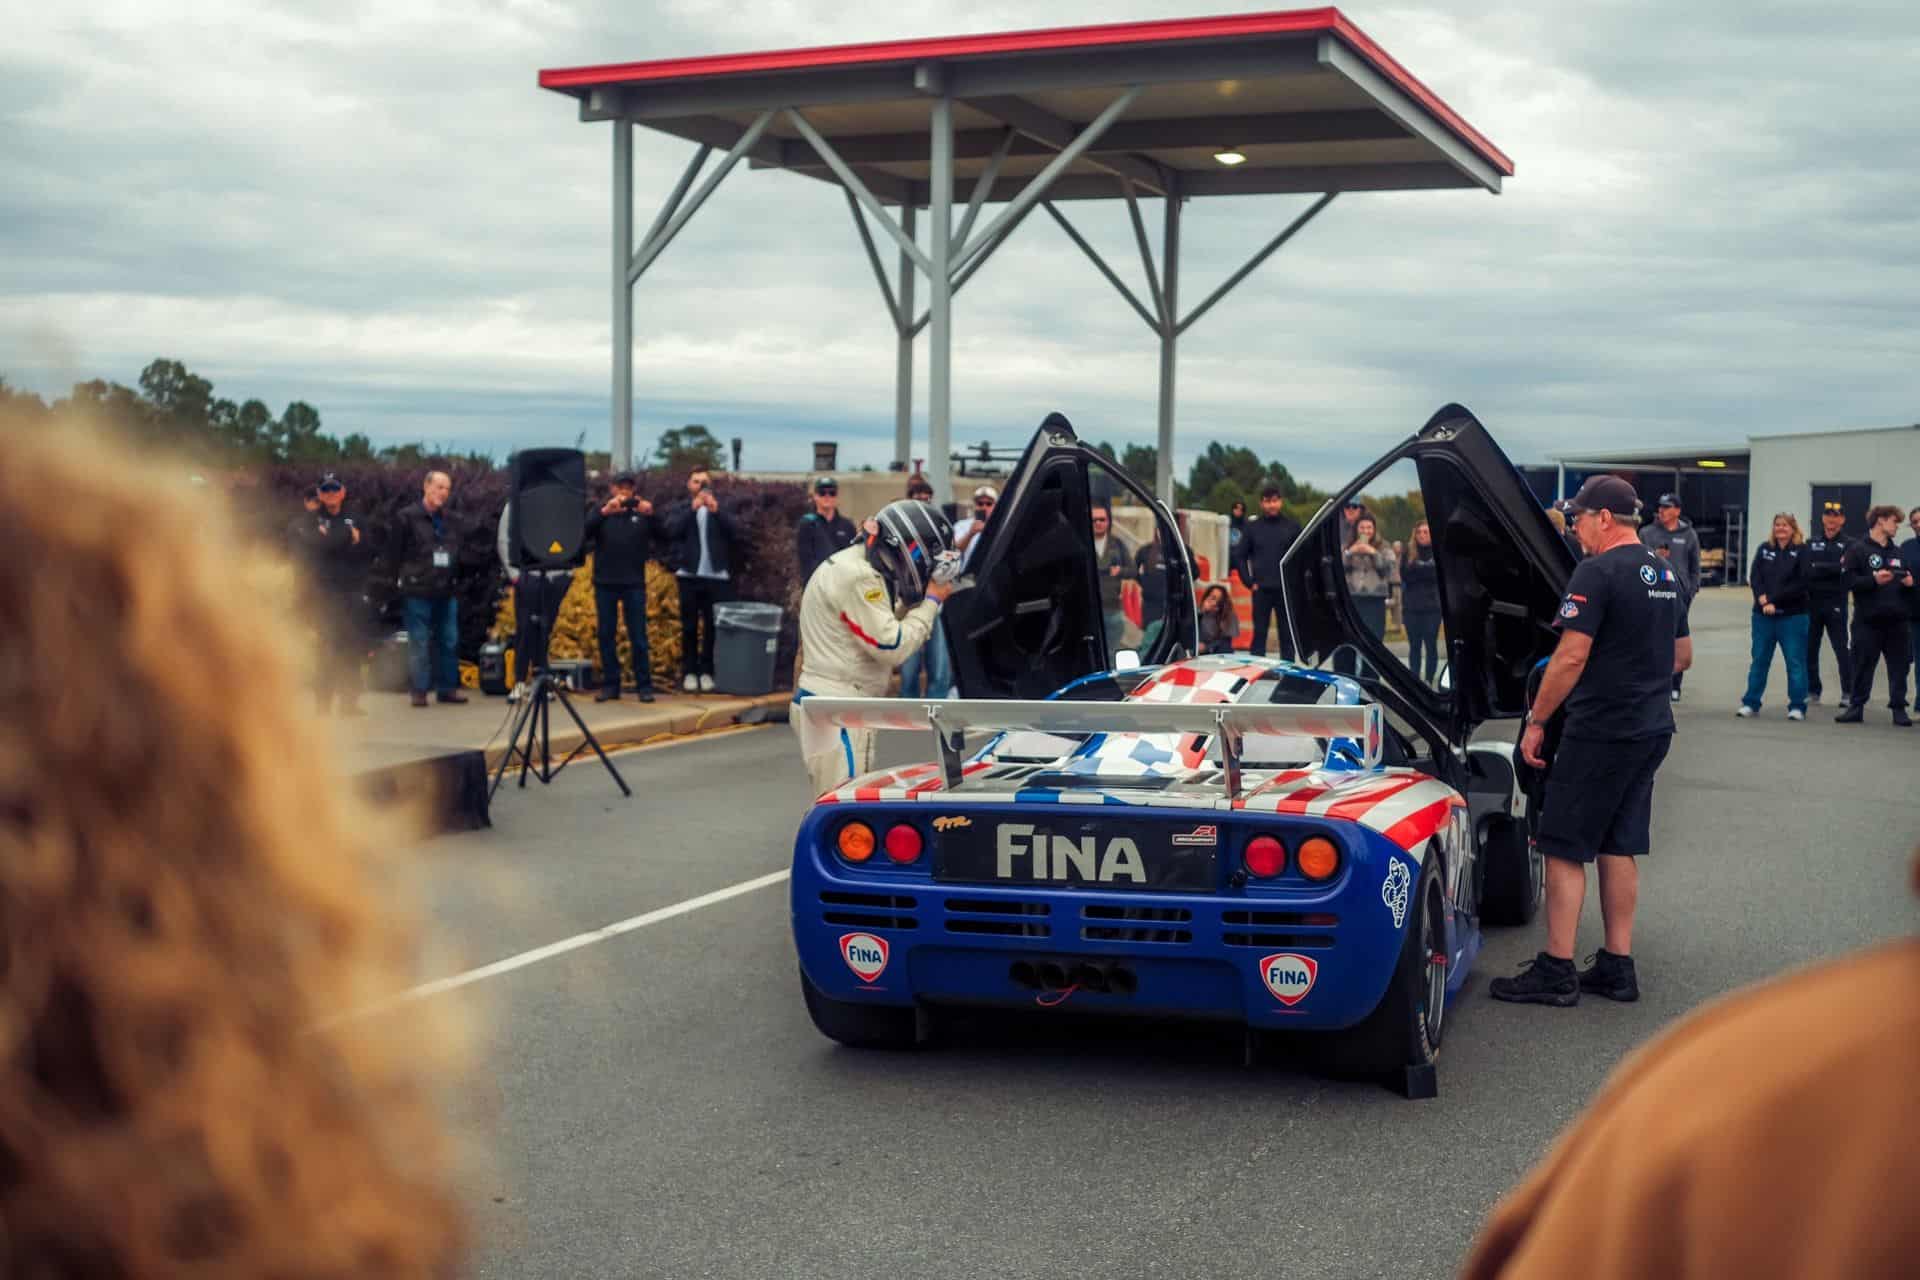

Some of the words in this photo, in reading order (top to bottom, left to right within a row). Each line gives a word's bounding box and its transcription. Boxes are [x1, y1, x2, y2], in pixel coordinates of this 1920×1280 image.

[997, 823, 1147, 883] FINA
[849, 945, 882, 963] FINA
[1270, 967, 1308, 985] FINA
